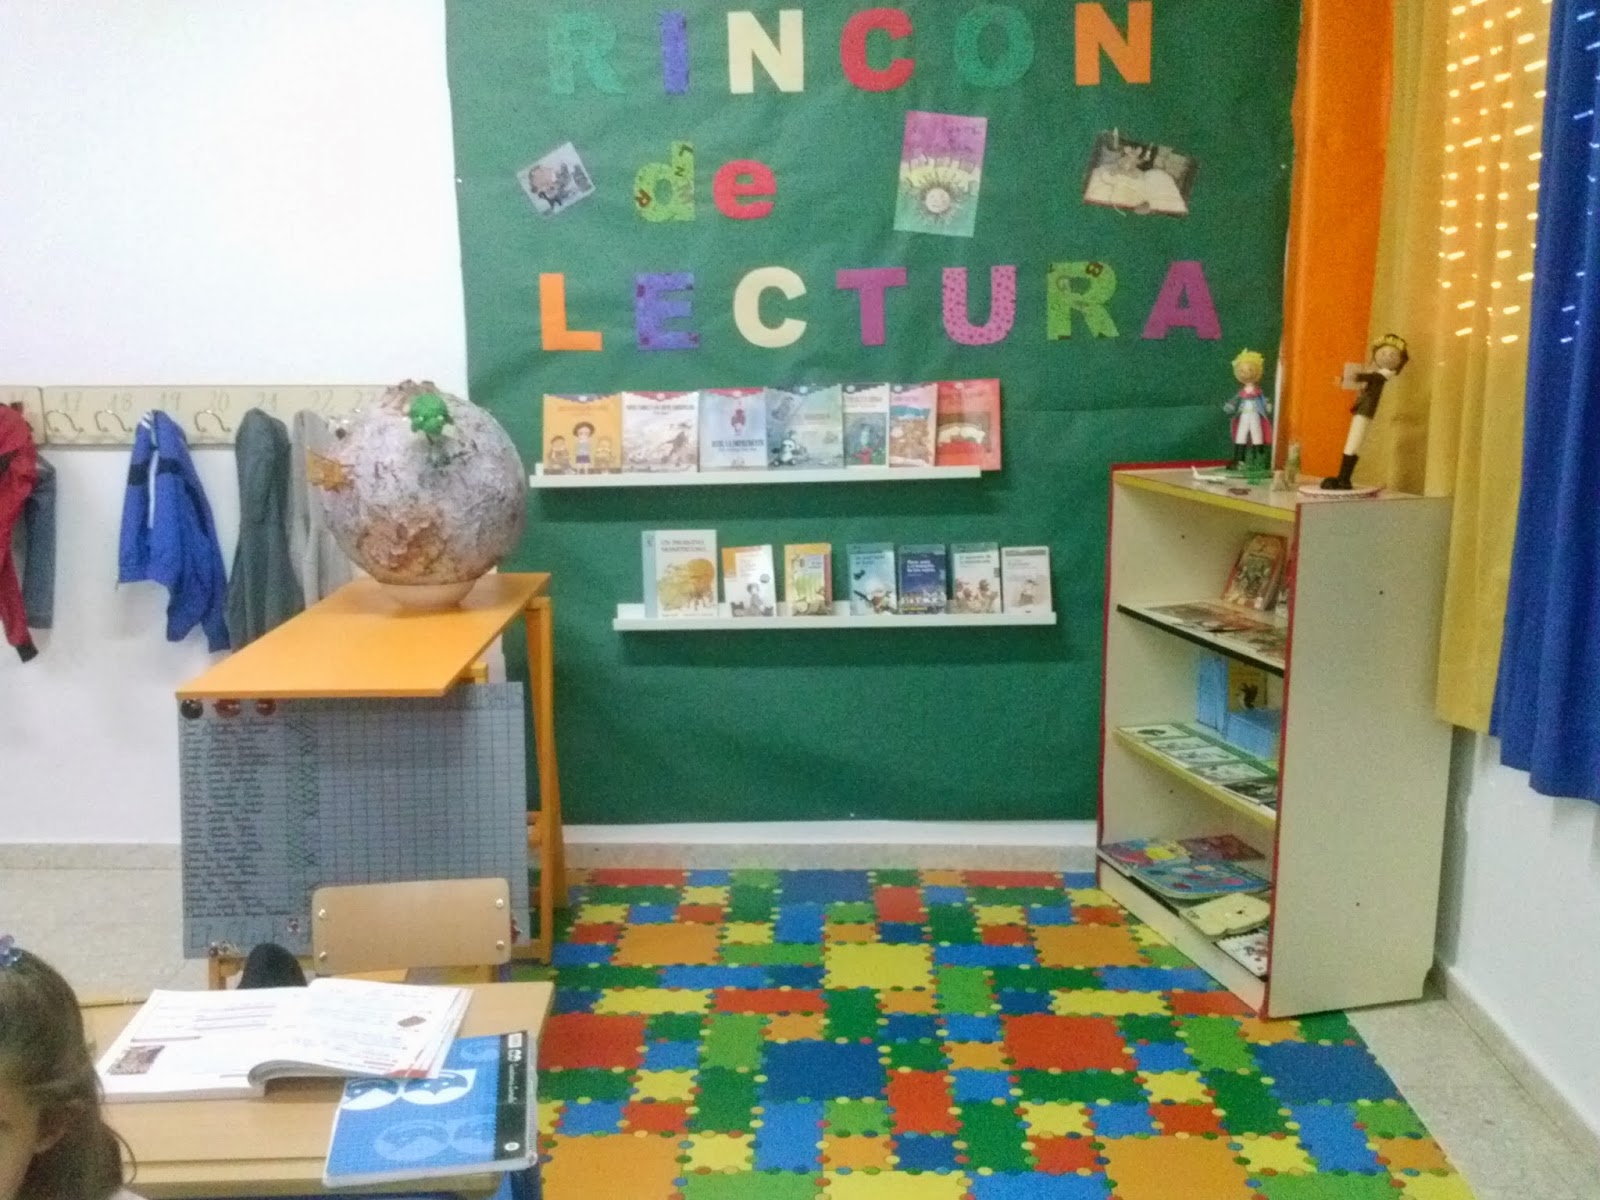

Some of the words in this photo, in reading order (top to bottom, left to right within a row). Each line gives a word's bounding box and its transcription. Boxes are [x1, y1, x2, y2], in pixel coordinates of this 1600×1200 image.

[547, 1, 1152, 96] RINCON
[633, 141, 776, 221] de
[538, 260, 1222, 351] LECTURA
[108, 391, 132, 412] 18
